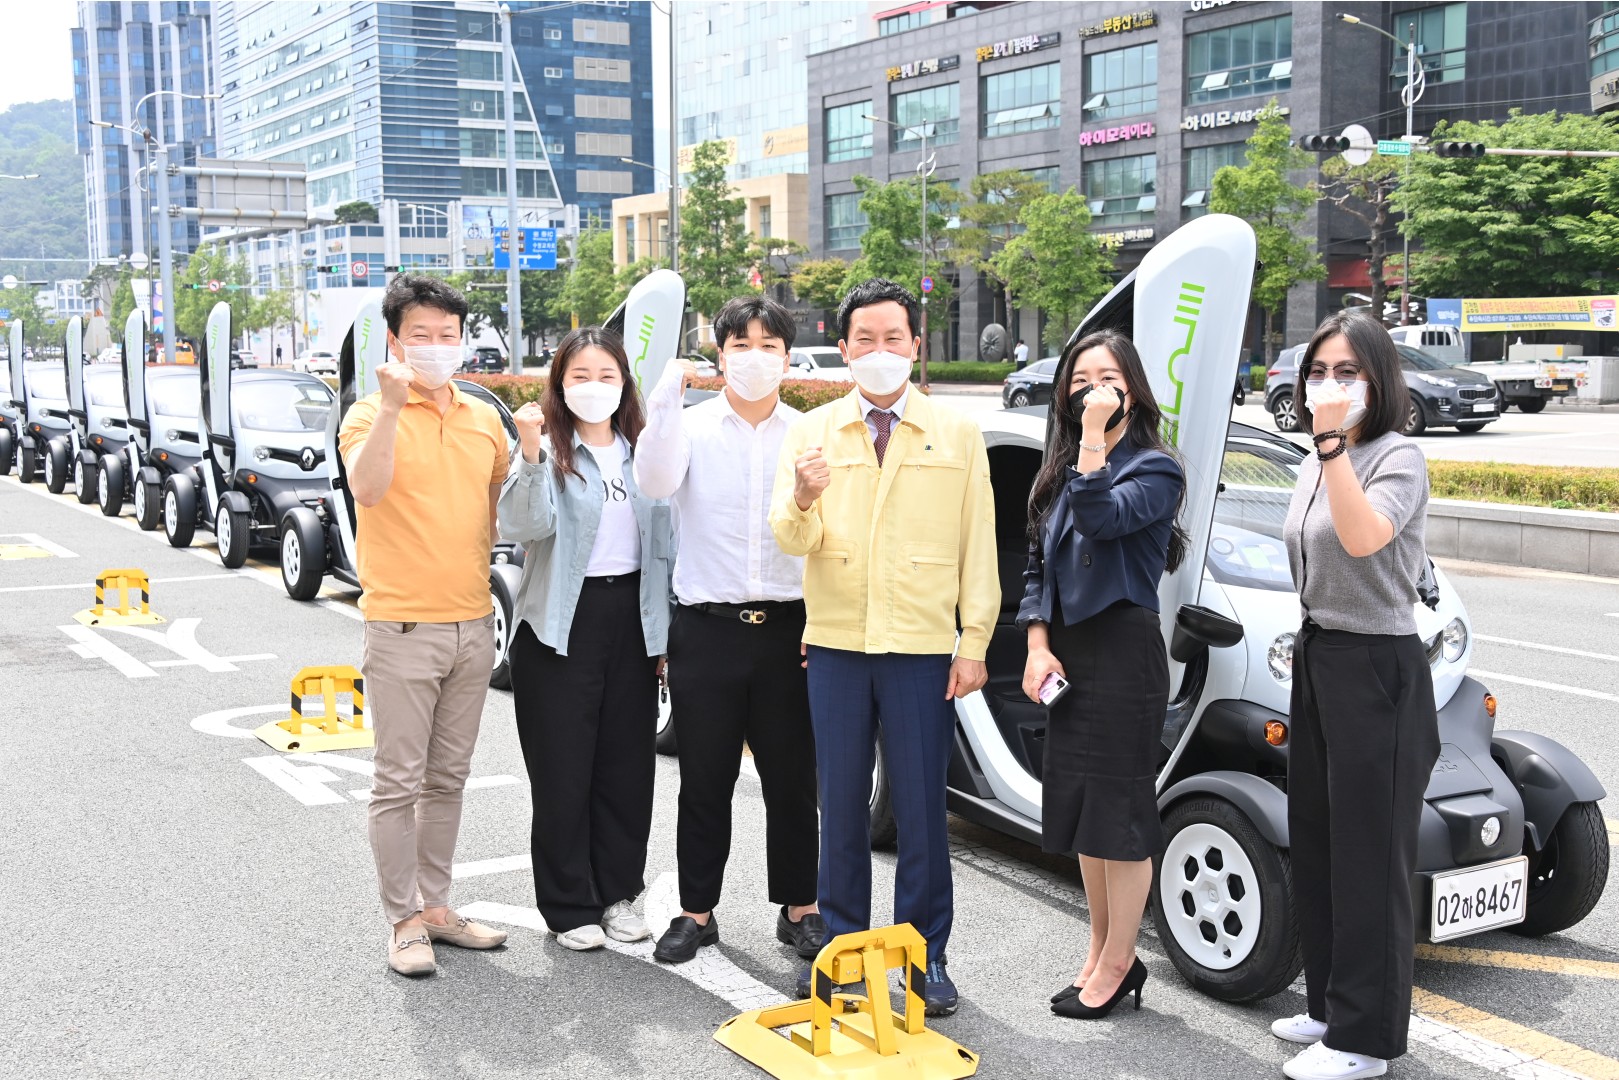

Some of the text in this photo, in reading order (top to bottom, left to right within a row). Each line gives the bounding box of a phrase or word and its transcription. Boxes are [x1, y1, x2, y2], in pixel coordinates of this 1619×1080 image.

[1103, 15, 1132, 33] 부동산
[1184, 110, 1231, 131] 하이모
[1079, 122, 1152, 146] 하이모레이디
[355, 265, 364, 273] 50
[1437, 879, 1522, 926] 02하8467
